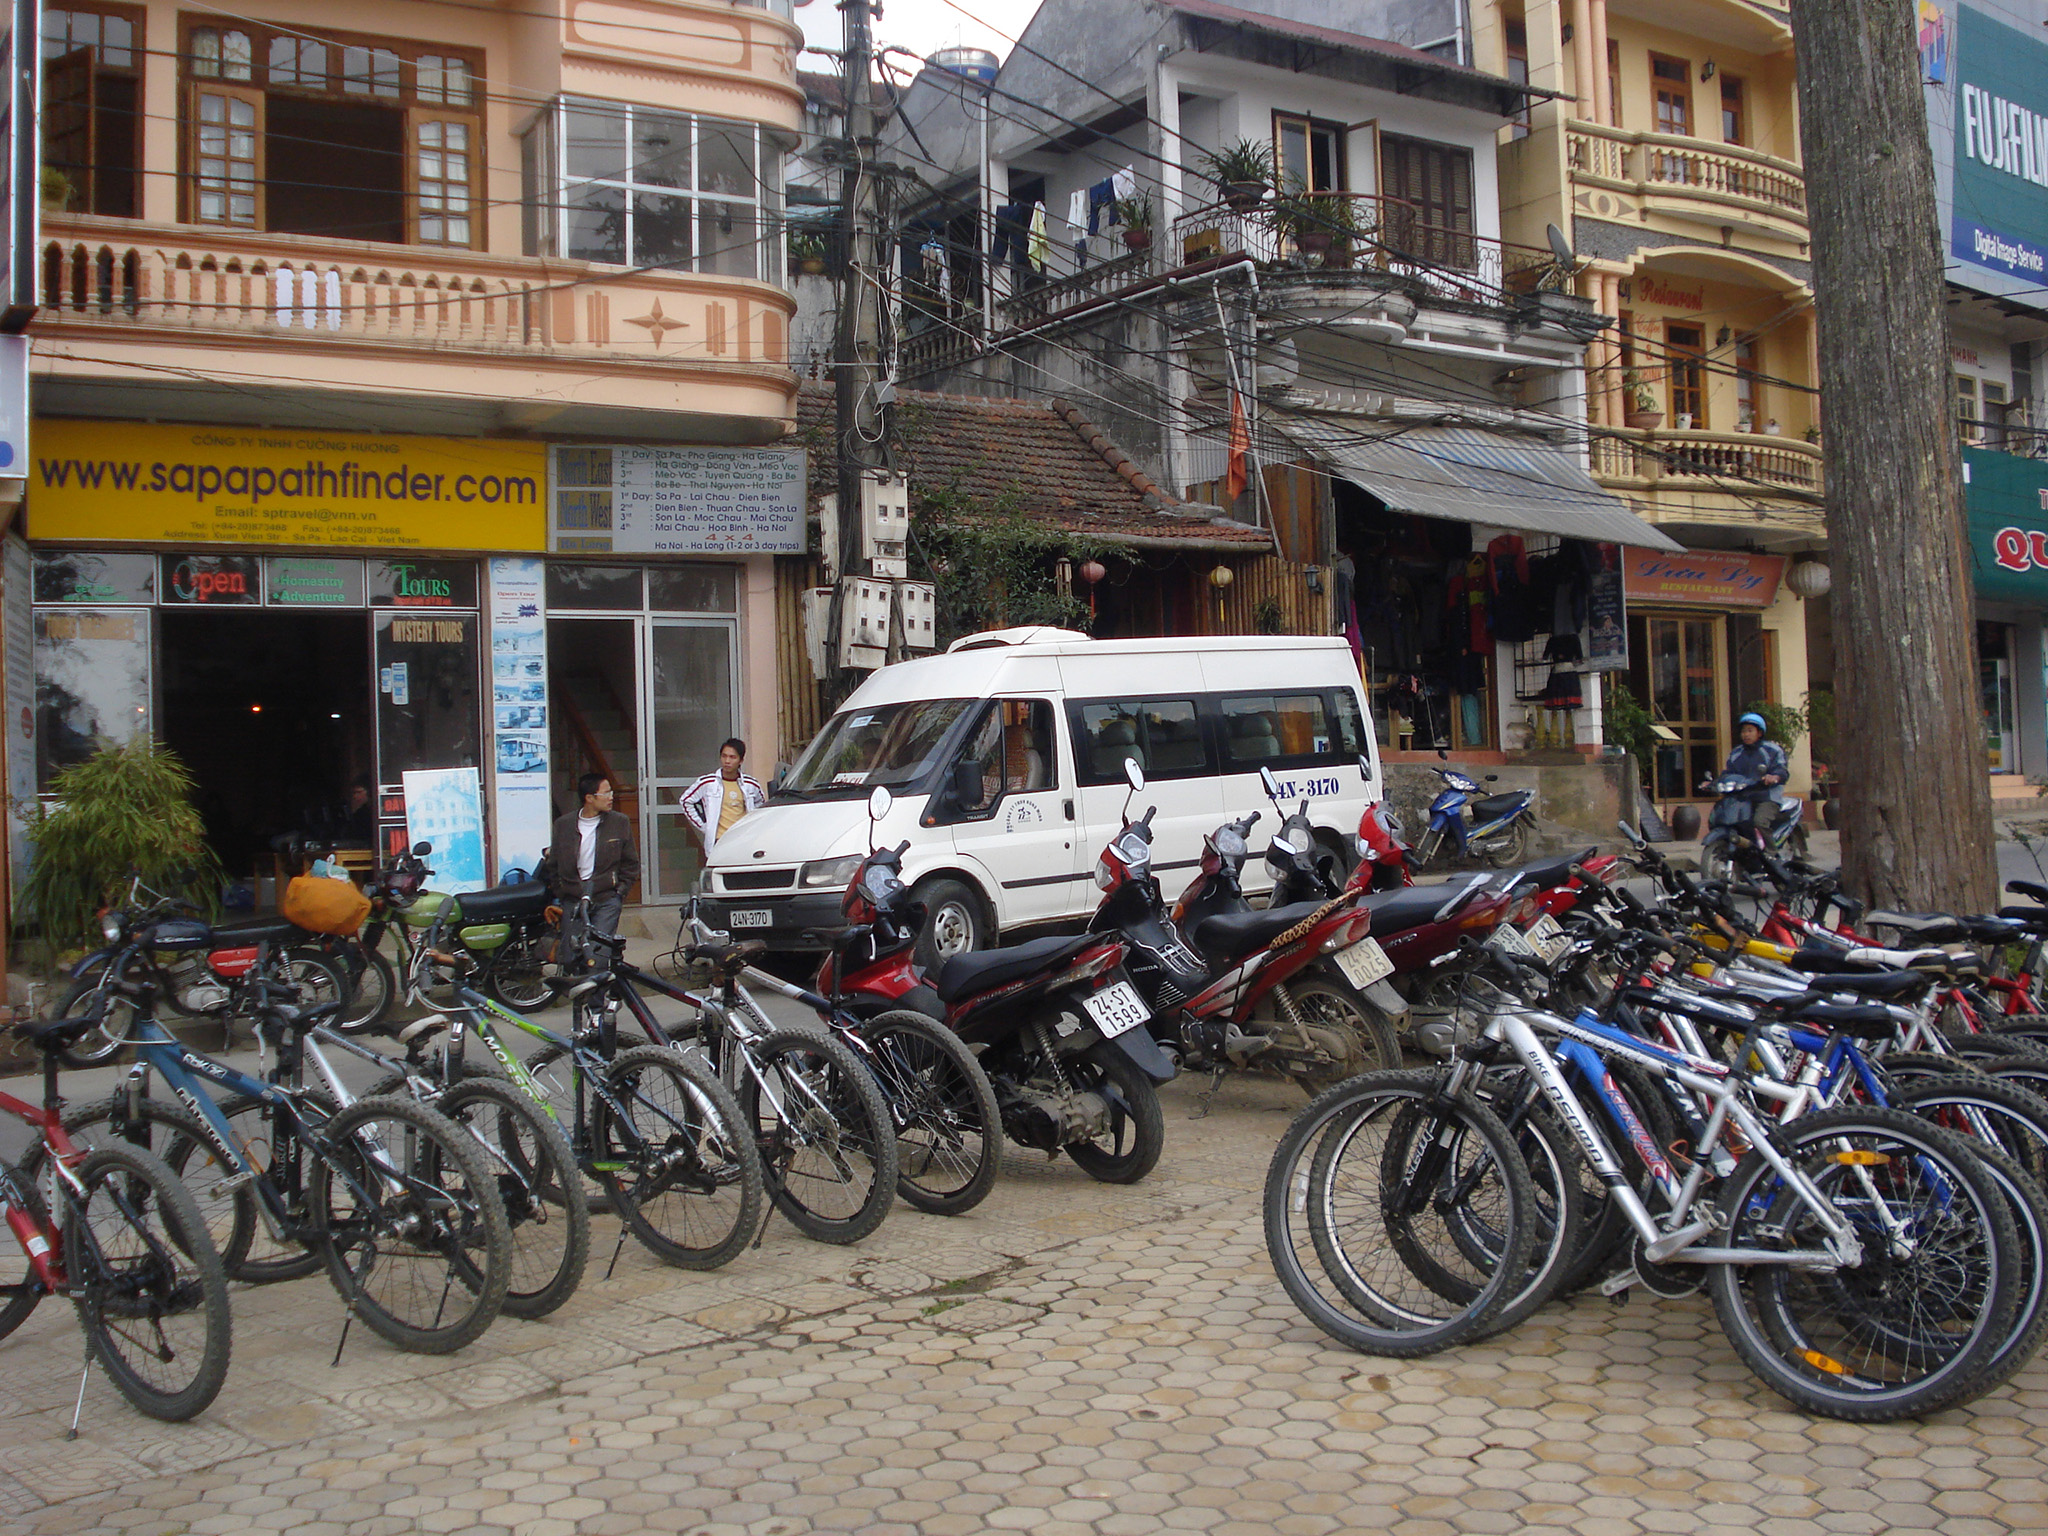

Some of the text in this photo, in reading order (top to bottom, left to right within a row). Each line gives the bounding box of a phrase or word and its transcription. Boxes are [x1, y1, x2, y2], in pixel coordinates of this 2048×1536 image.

[1975, 229, 1997, 260] Digital
[2017, 244, 2043, 272] Service
[39, 457, 537, 504] www.sapapathfinder.com
[655, 492, 667, 500] Sa
[669, 493, 681, 501] Pa
[690, 493, 703, 501] Lai
[705, 493, 730, 501] Chau
[738, 493, 761, 501] Dien
[761, 493, 780, 501] Bien
[215, 506, 376, 522] Email: sptravel@vnn.vn
[655, 503, 676, 512] Dien
[678, 504, 698, 512] Bien
[706, 504, 733, 512] Thuan
[735, 504, 760, 512] Chau
[768, 505, 785, 513] Son
[787, 505, 797, 513] La
[655, 513, 673, 521] Son
[694, 514, 714, 522] Moc
[716, 514, 742, 522] Chau
[750, 514, 767, 522] Mai
[768, 514, 794, 523] Chau
[655, 523, 672, 531] Mai
[674, 523, 699, 531] Chau
[708, 524, 727, 532] Hoa
[729, 524, 748, 532] Binh
[756, 524, 769, 532] Ha
[771, 524, 787, 532] Noi
[705, 533, 718, 541] 4
[742, 533, 754, 541] 4
[654, 542, 667, 550] Ha
[668, 542, 683, 550] Noi
[690, 542, 702, 550] Ha
[704, 542, 725, 552] Long
[761, 542, 778, 551] day
[779, 542, 799, 551] trips)
[172, 560, 246, 602] Open
[280, 574, 344, 589] Homestay
[1660, 582, 1734, 595] RESTAURANT
[280, 590, 345, 602] Adventure
[393, 620, 464, 643] MYSTERY TOURS
[1307, 777, 1339, 797] 3170
[732, 911, 768, 926] 24N-3170
[1132, 964, 1159, 973] HONDA
[1353, 960, 1388, 984] 0045
[1105, 1004, 1142, 1032] 1599
[1528, 1050, 1551, 1079] BIKE
